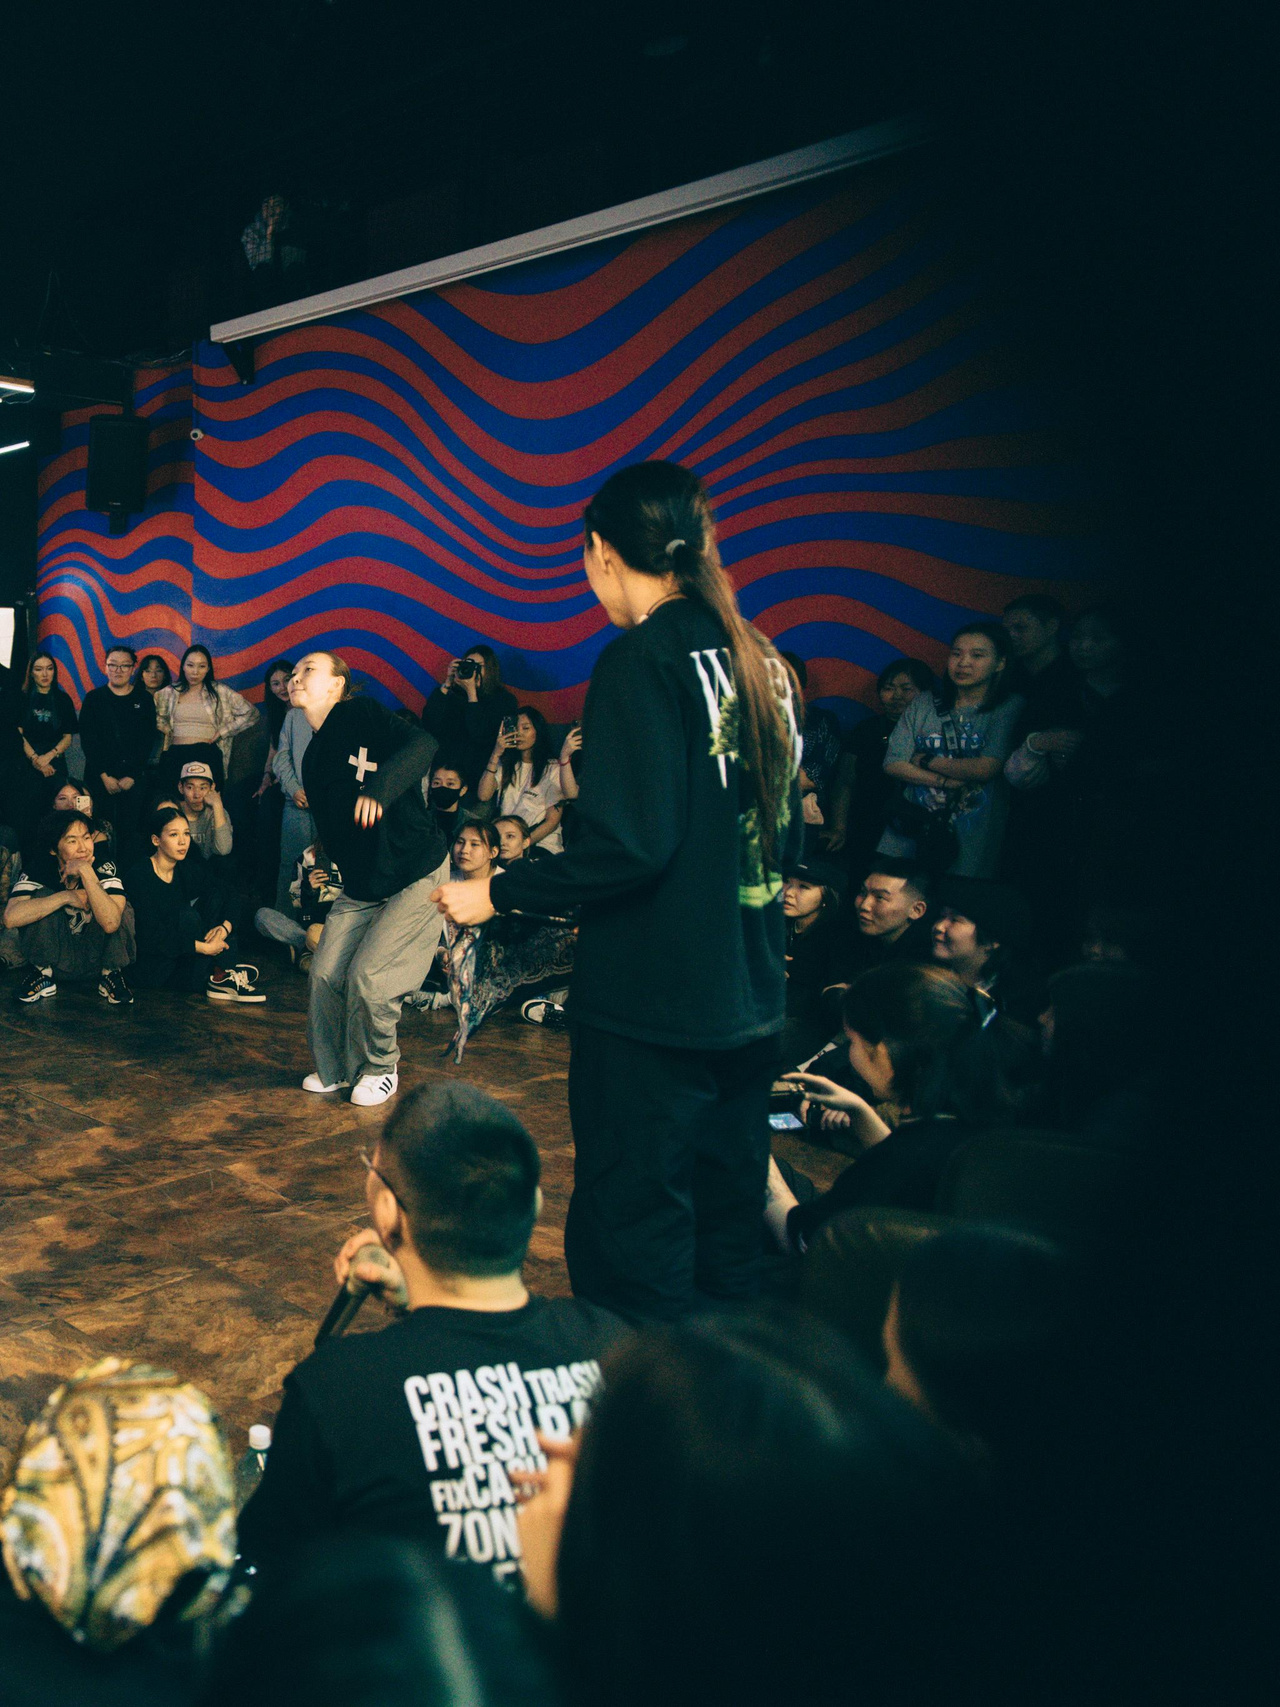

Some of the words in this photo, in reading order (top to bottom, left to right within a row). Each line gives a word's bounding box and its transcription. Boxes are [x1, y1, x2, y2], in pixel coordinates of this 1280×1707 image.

[404, 1361, 532, 1424] CRASH
[416, 1404, 541, 1472] FRESH
[429, 1479, 468, 1513] FIX
